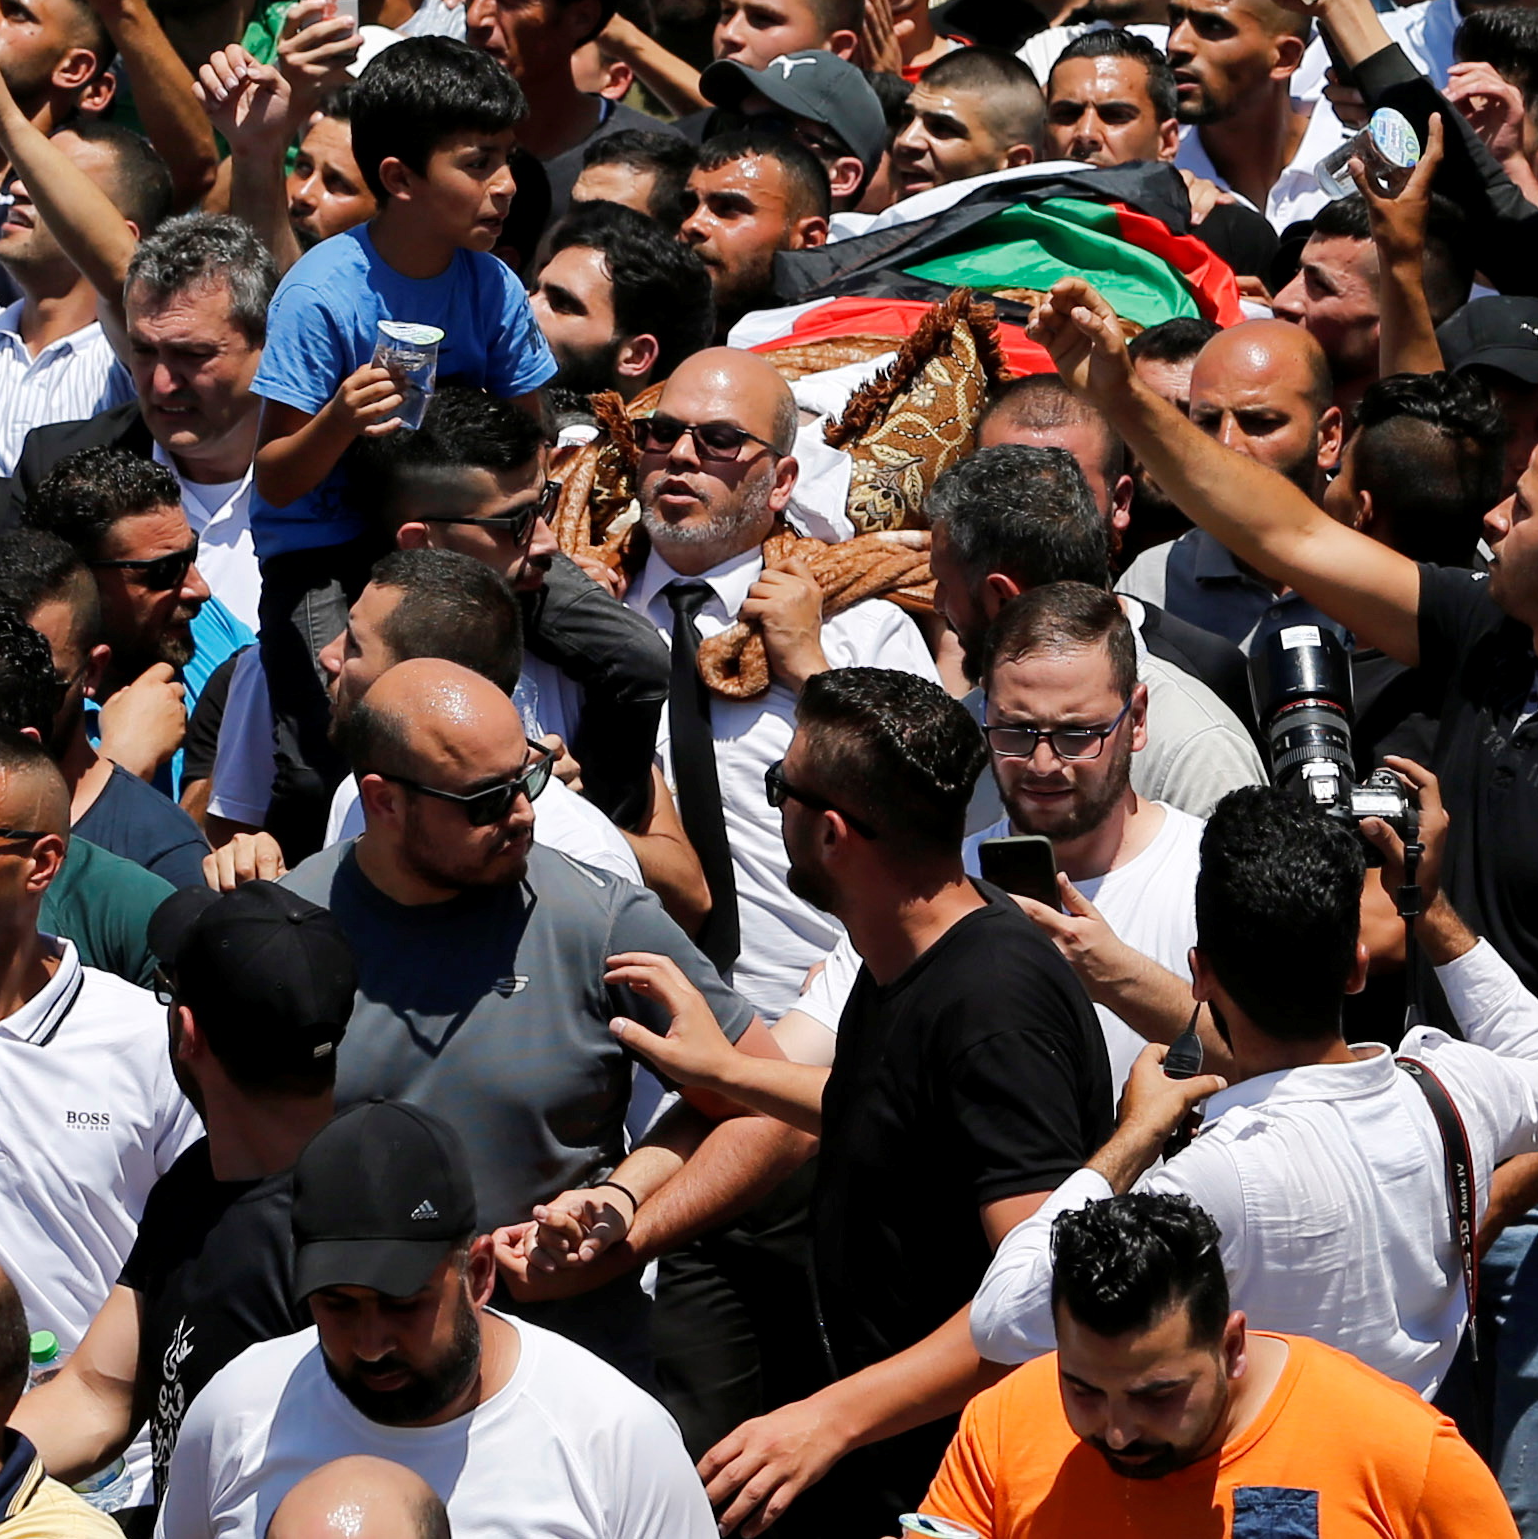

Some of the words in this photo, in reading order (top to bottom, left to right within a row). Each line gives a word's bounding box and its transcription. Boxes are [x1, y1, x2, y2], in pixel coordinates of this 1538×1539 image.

[66, 1111, 110, 1126] BOSS
[1456, 1162, 1467, 1177] IV
[1458, 1178, 1469, 1215] Mark
